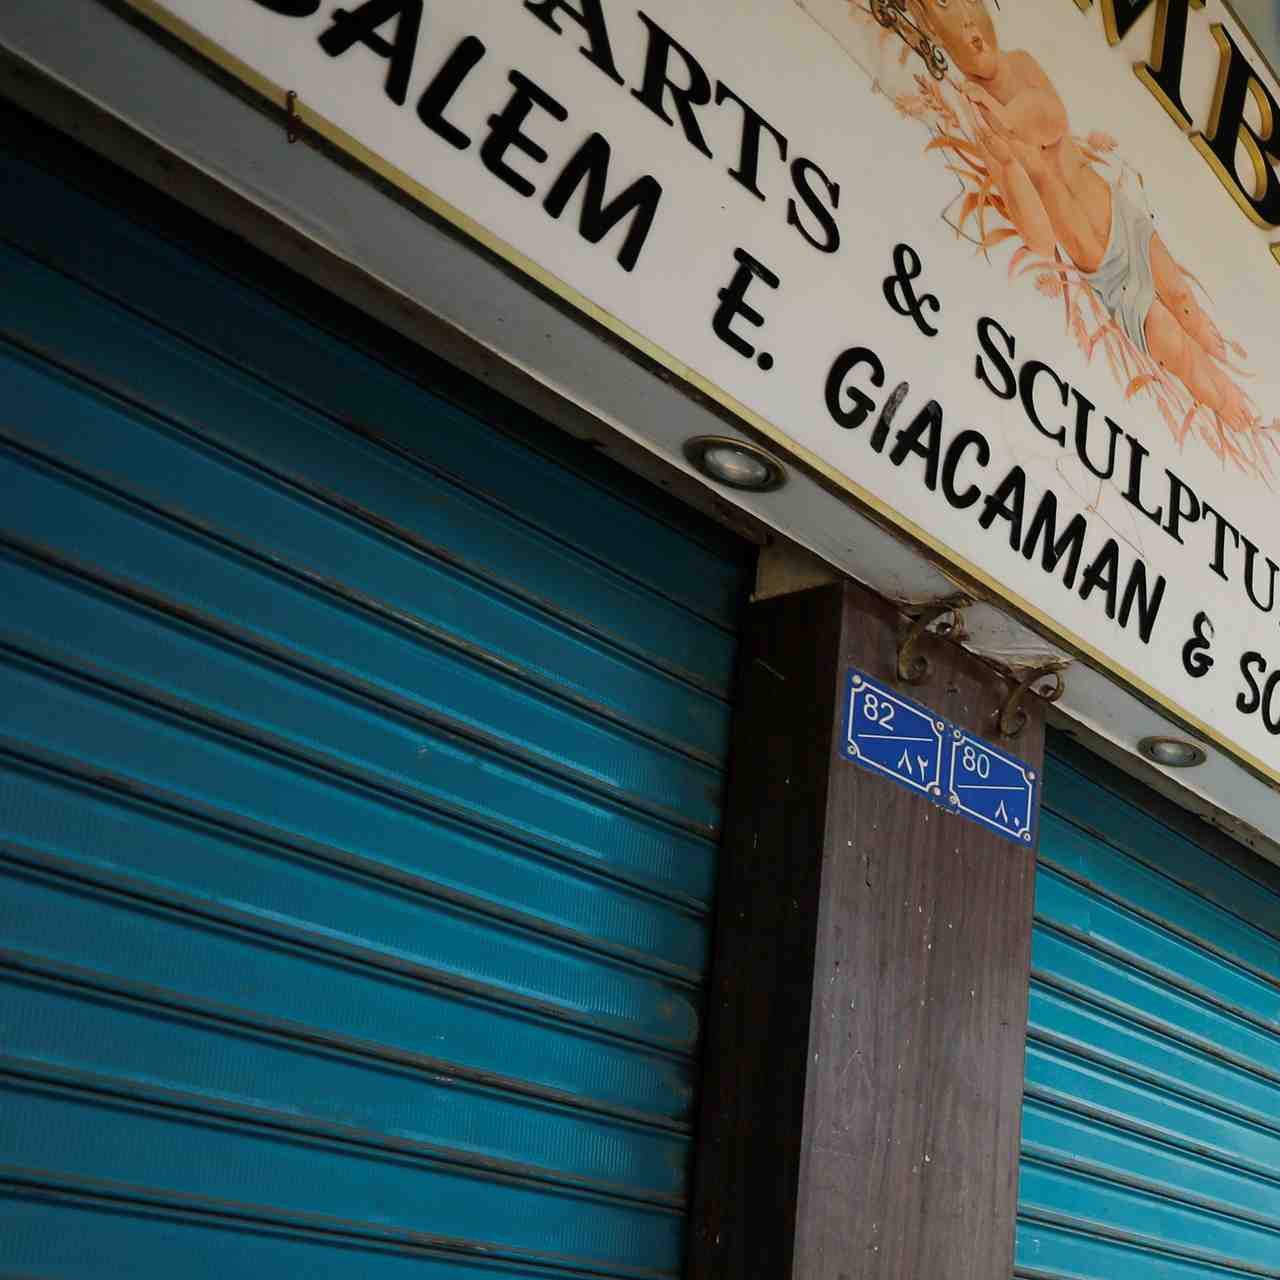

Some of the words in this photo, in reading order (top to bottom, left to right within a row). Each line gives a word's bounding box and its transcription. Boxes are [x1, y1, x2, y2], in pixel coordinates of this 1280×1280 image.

[881, 242, 940, 336] &
[251, 0, 663, 272] ALEM
[711, 247, 776, 371] E.
[824, 346, 1167, 645] GIACAMAN
[1181, 610, 1216, 678] &
[863, 693, 896, 732] 82
[897, 748, 929, 782] ٨٢
[962, 745, 990, 779] 80
